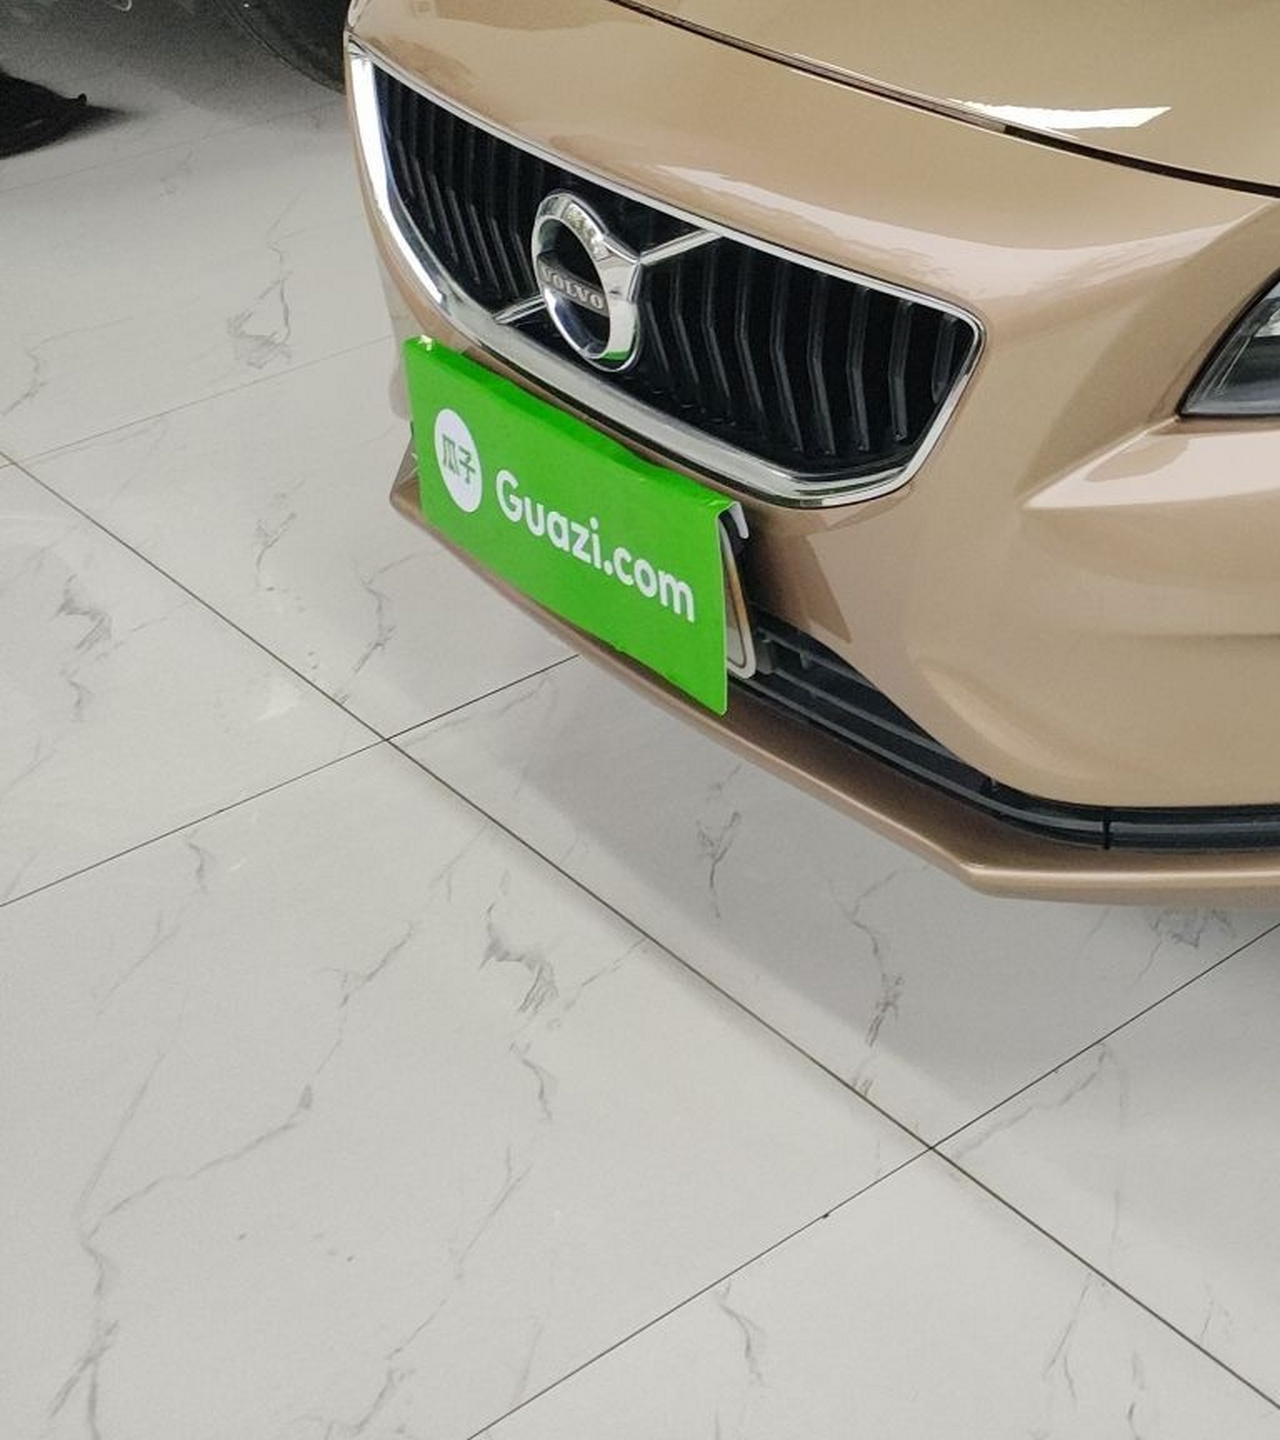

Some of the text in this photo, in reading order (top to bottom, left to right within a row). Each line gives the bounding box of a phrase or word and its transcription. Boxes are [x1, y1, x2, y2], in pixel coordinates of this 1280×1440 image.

[539, 259, 604, 310] VOLVO
[442, 432, 477, 486] 瓜子
[495, 468, 695, 624] Guazi.com
